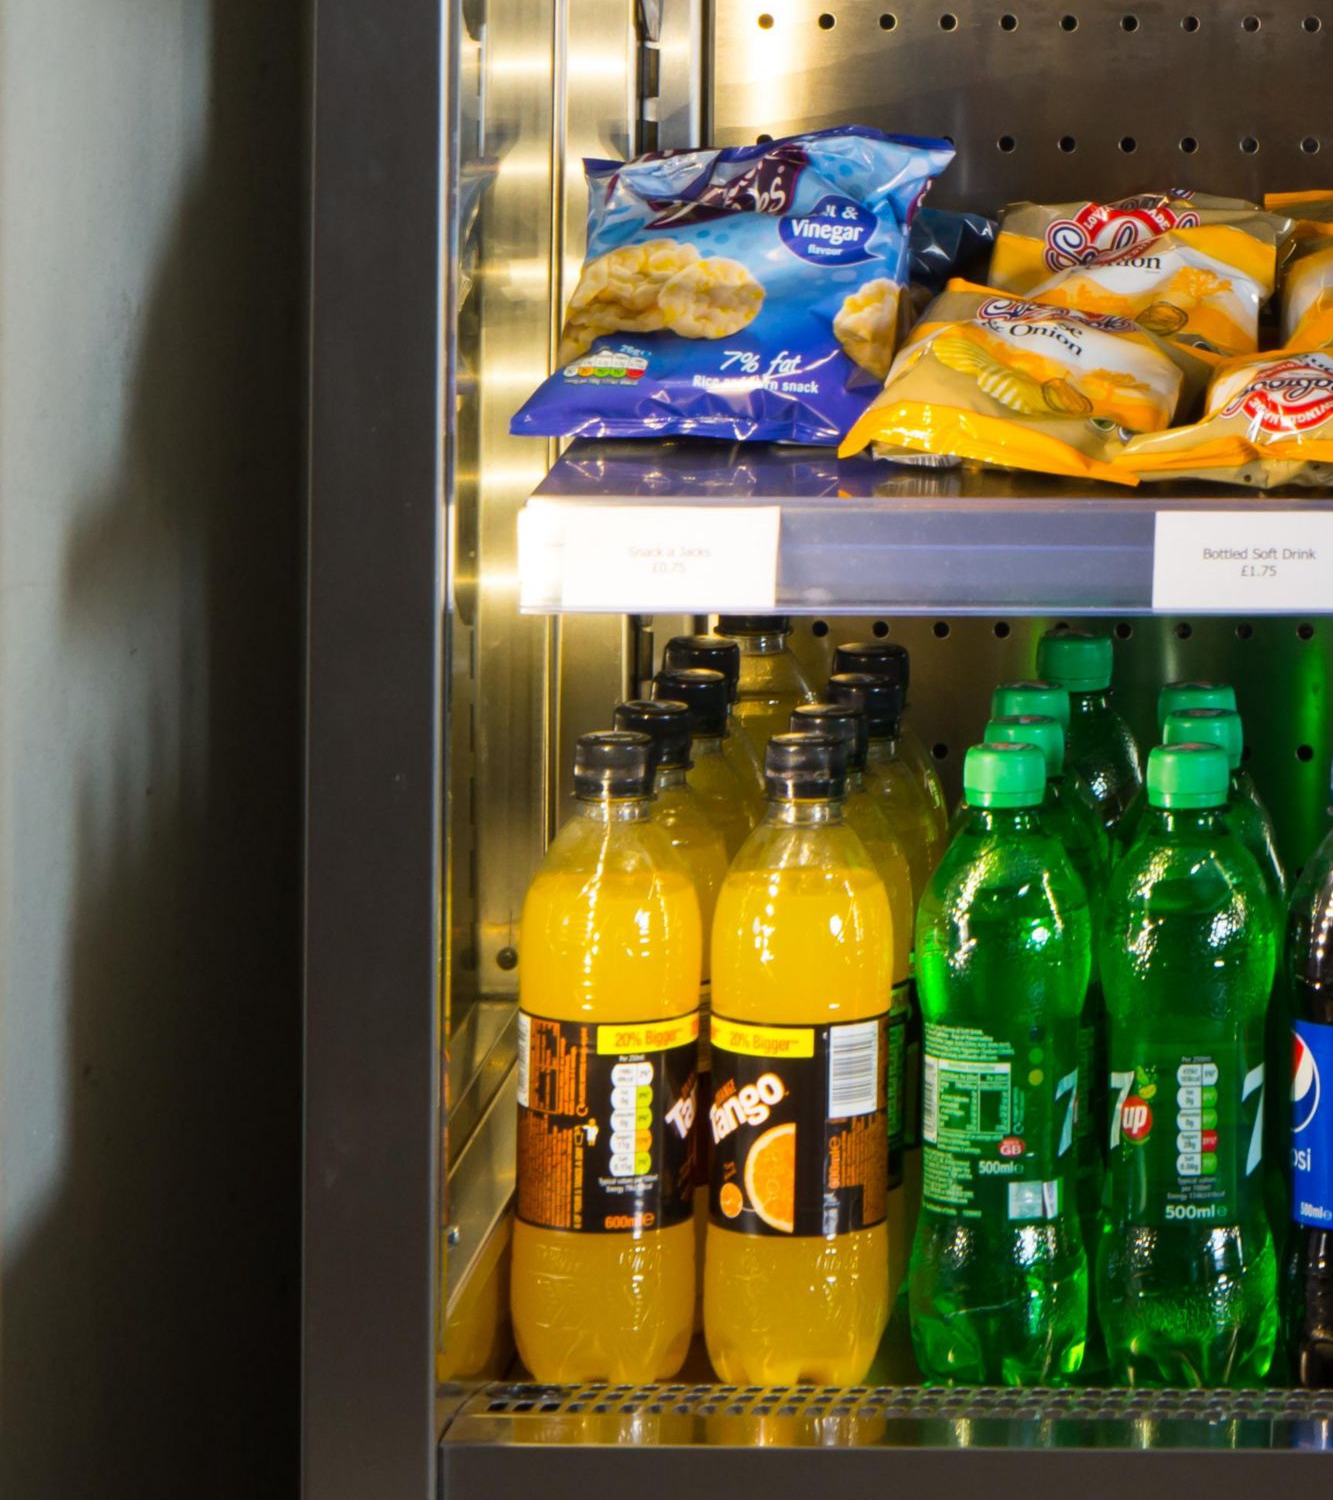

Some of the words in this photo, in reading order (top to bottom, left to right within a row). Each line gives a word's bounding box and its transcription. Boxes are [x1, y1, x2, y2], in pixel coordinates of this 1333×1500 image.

[791, 217, 865, 244] Vinegar
[1009, 322, 1083, 357] Onion
[720, 350, 760, 373] 7%
[764, 350, 802, 379] fat
[782, 380, 818, 393] snack
[1203, 547, 1249, 560] Bottled
[1253, 547, 1278, 560] Soft
[1283, 547, 1317, 560] Drink
[1241, 565, 1277, 577] £1.75
[709, 1073, 790, 1145] Tango
[979, 1160, 1013, 1175] 500ml
[1165, 1204, 1216, 1220] 500ml
